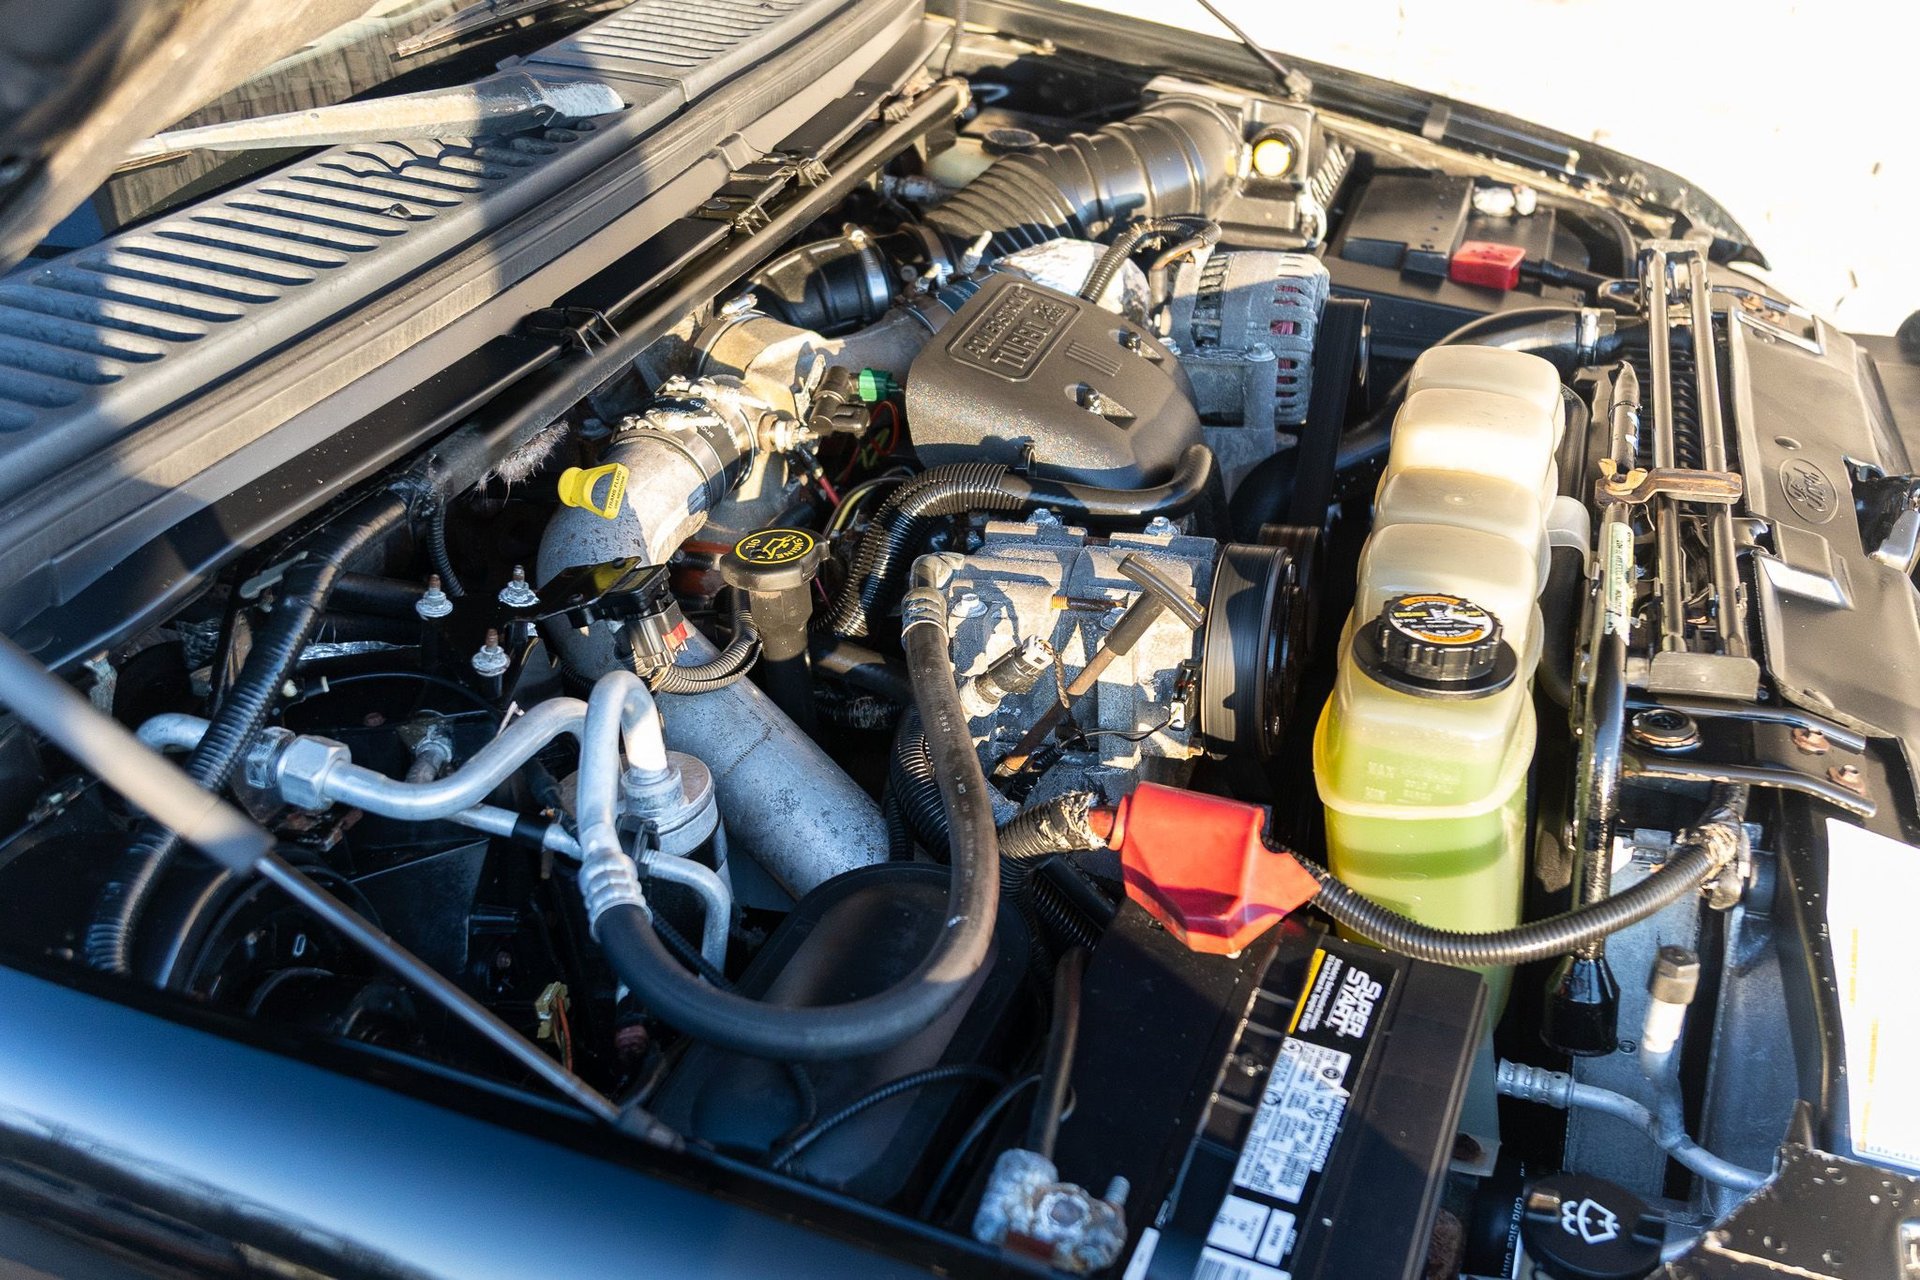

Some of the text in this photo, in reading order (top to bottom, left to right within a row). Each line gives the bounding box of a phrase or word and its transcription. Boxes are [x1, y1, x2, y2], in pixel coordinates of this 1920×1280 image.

[991, 320, 1053, 369] TURBO
[608, 470, 622, 509] TRANS FLUID
[1785, 466, 1828, 512] Ford
[745, 538, 761, 550] OIL
[775, 537, 804, 559] ENGINE
[1330, 966, 1370, 1035] START
[1346, 981, 1383, 1038] SUPER
